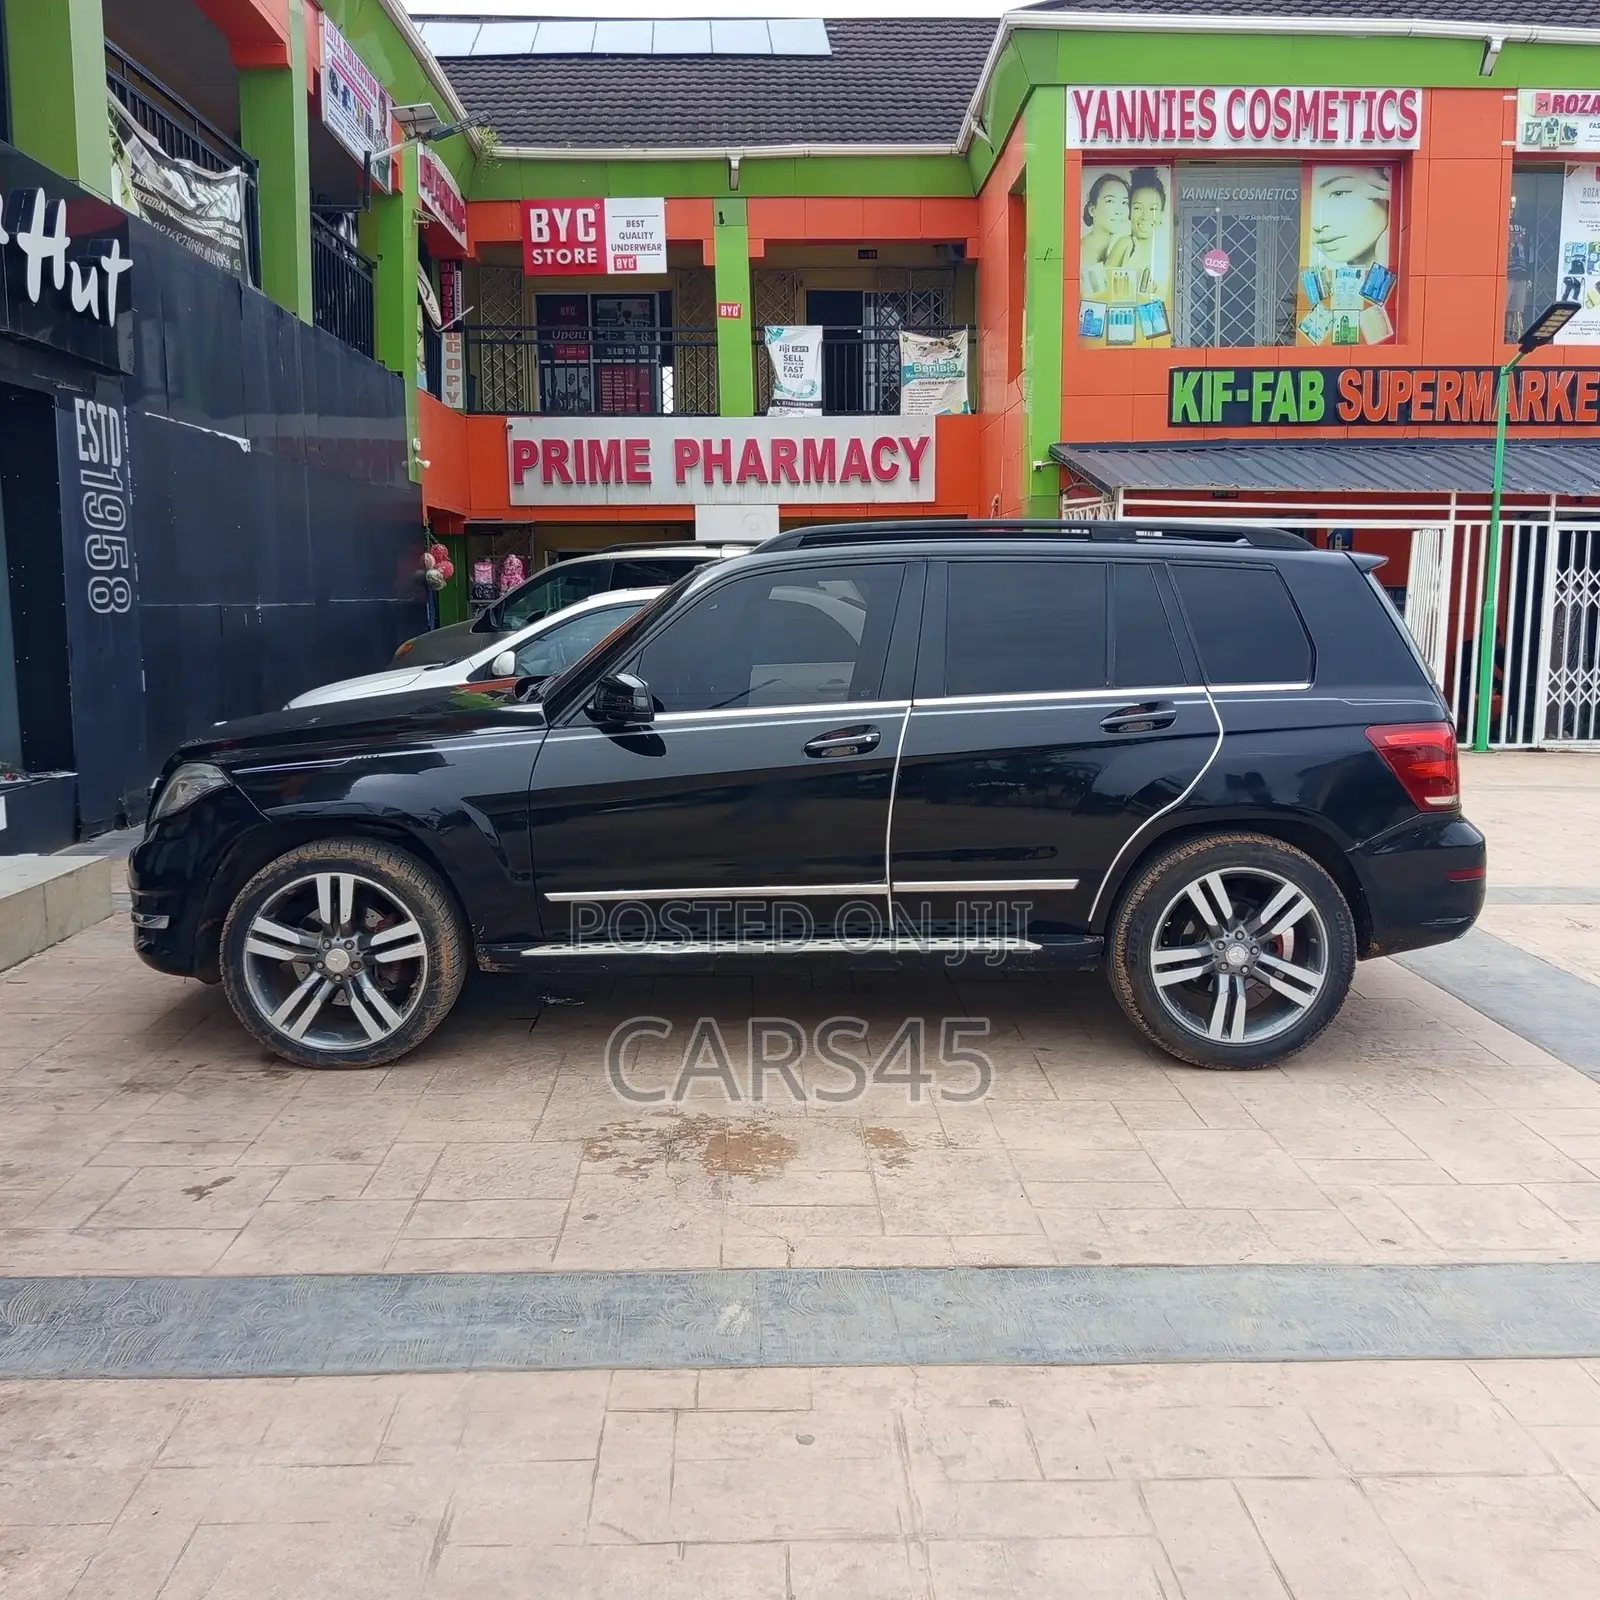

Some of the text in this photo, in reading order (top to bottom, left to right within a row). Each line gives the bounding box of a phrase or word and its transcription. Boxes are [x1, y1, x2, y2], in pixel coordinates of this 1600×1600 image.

[1072, 88, 1418, 142] YANNIES COSMETICS
[1181, 187, 1299, 201] YANNIES COSMETICS
[529, 208, 597, 243] BYC
[626, 220, 645, 228] BEST
[618, 231, 654, 240] QUALITY
[611, 243, 662, 252] UNDERWEAR
[17, 187, 134, 328] Hut
[532, 248, 598, 265] STORE
[616, 257, 635, 269] BYC
[1205, 257, 1229, 269] CLOSE
[720, 304, 739, 317] BYC
[783, 354, 804, 362] SELL
[1172, 370, 1325, 423] KIF-FAB
[74, 397, 122, 468] ESTD
[512, 435, 931, 484] PRIME PHARMACY
[80, 467, 132, 614] 1958
